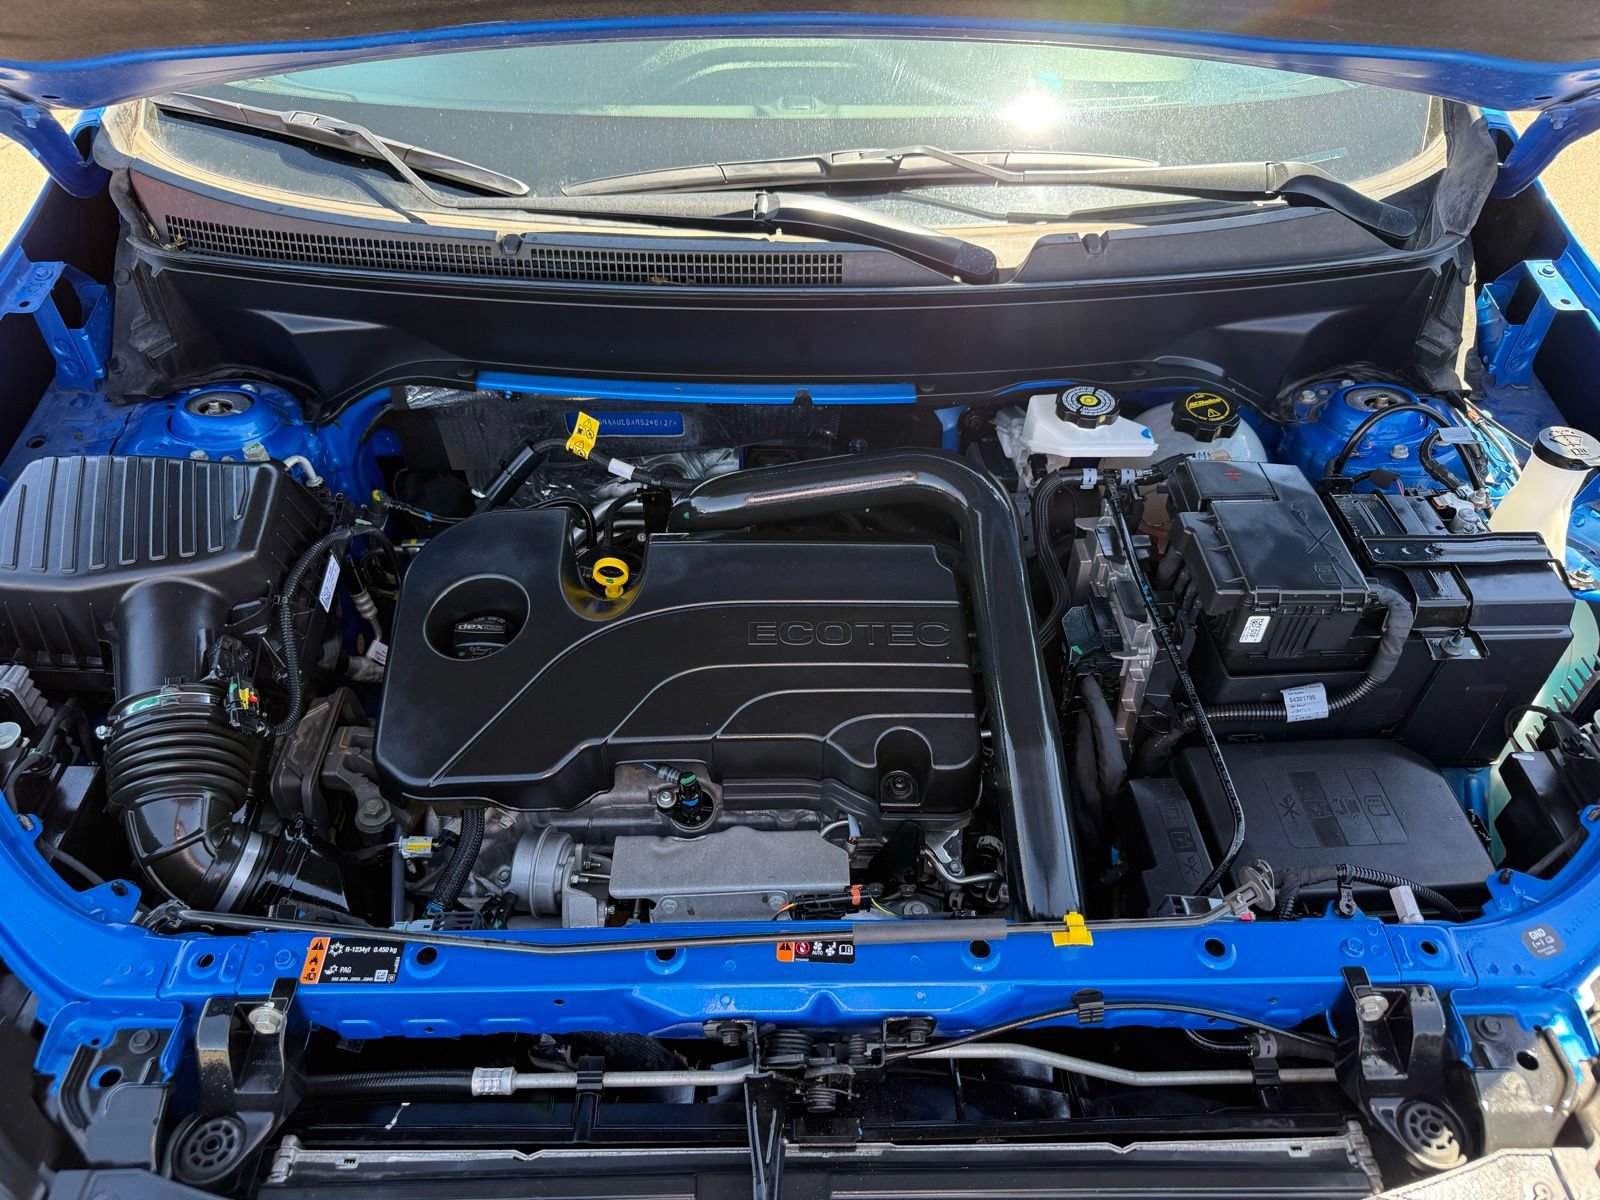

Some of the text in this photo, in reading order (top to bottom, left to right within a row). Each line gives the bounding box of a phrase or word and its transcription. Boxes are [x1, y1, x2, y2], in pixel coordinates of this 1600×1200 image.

[1188, 398, 1221, 409] ACDelco
[458, 623, 503, 631] dexos
[747, 620, 951, 647] ECOTEC
[1528, 927, 1546, 941] GND
[345, 946, 371, 954] R-1234yf
[389, 946, 398, 954] kg
[339, 966, 352, 974] PAG
